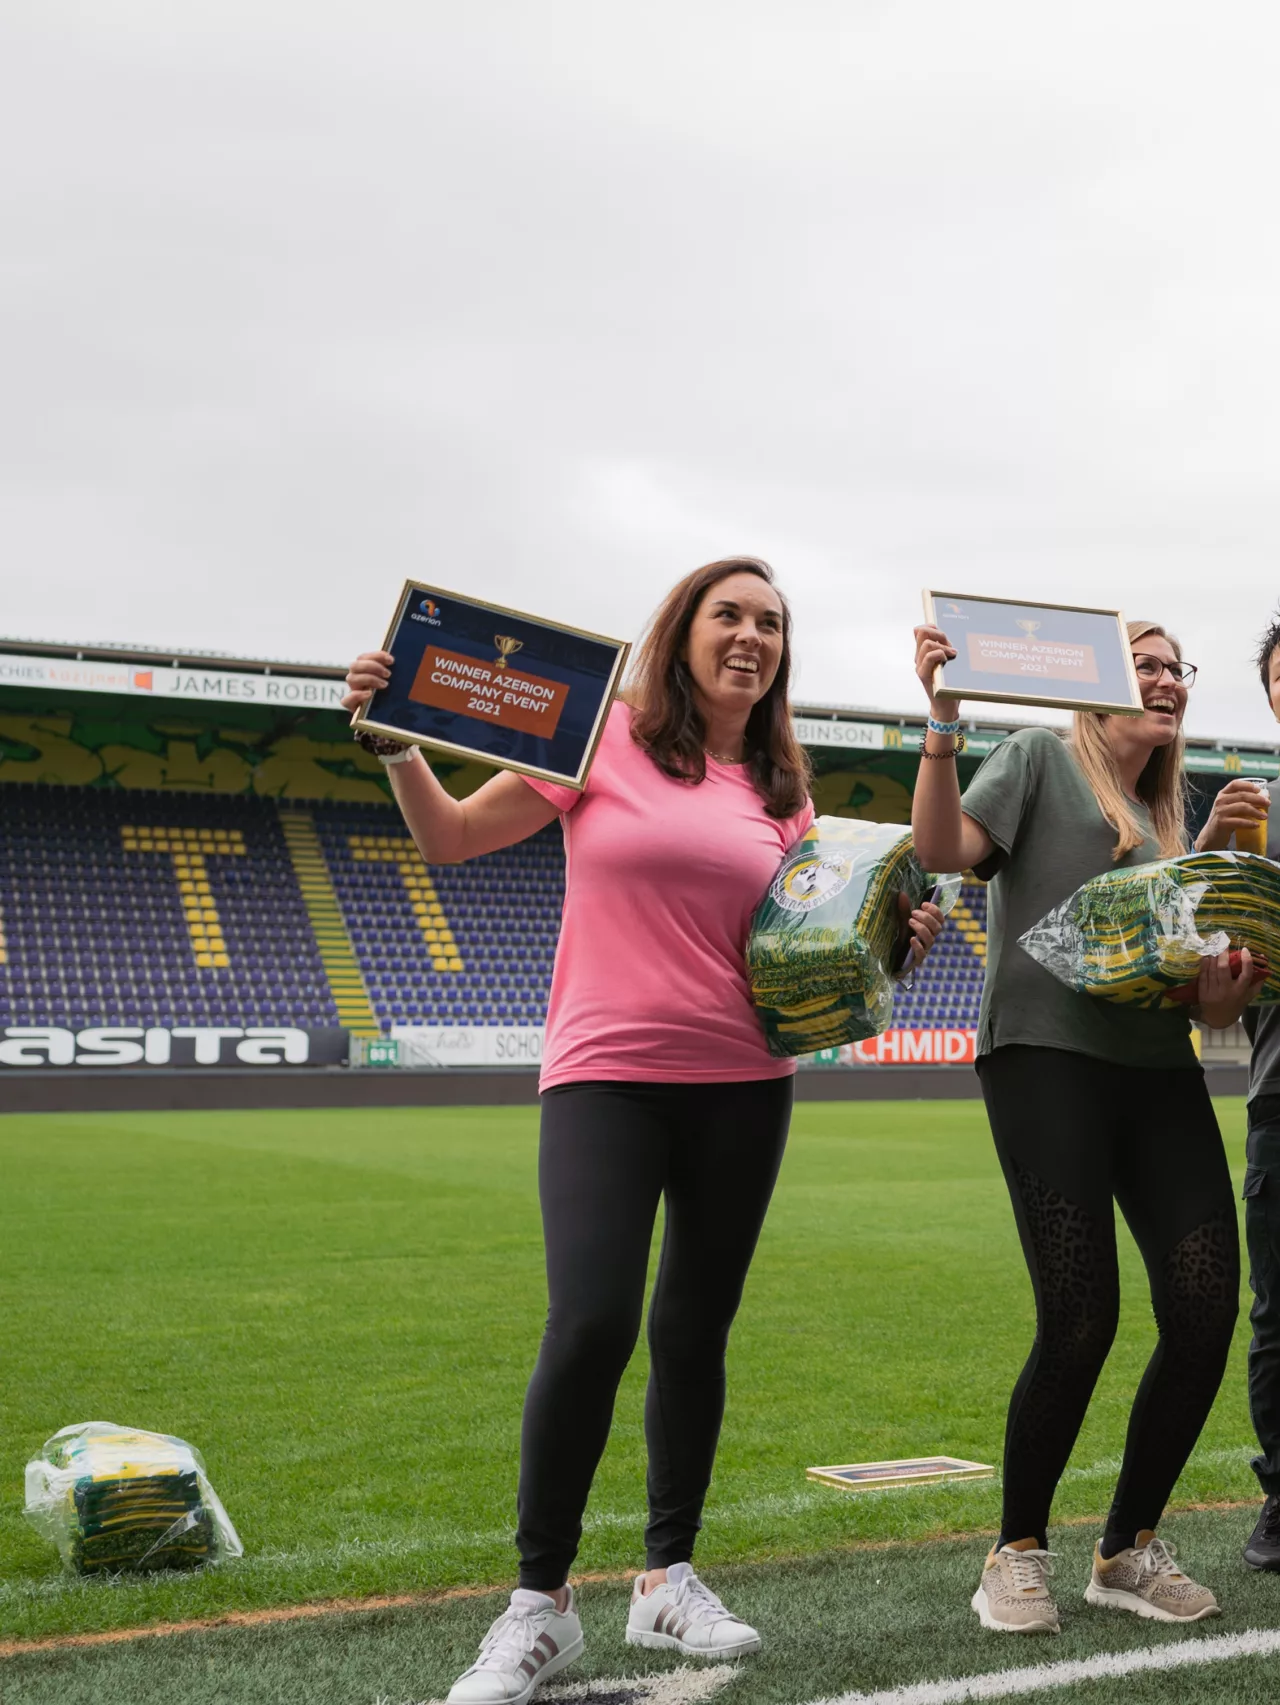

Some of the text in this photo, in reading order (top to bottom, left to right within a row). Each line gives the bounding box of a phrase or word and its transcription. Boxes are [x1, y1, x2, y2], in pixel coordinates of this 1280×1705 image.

[411, 613, 441, 627] azerion
[978, 639, 1084, 658] WINNER AZERION
[980, 649, 1084, 667] COMPANY EVENT
[434, 656, 555, 700] WINNER AZERION
[1020, 662, 1049, 673] 2021
[170, 674, 345, 702] JAMES ROBIN
[430, 671, 549, 713] COMPANY EVENT
[467, 697, 501, 716] 2021
[796, 721, 874, 744] BINSON
[496, 1033, 544, 1058] SCHO
